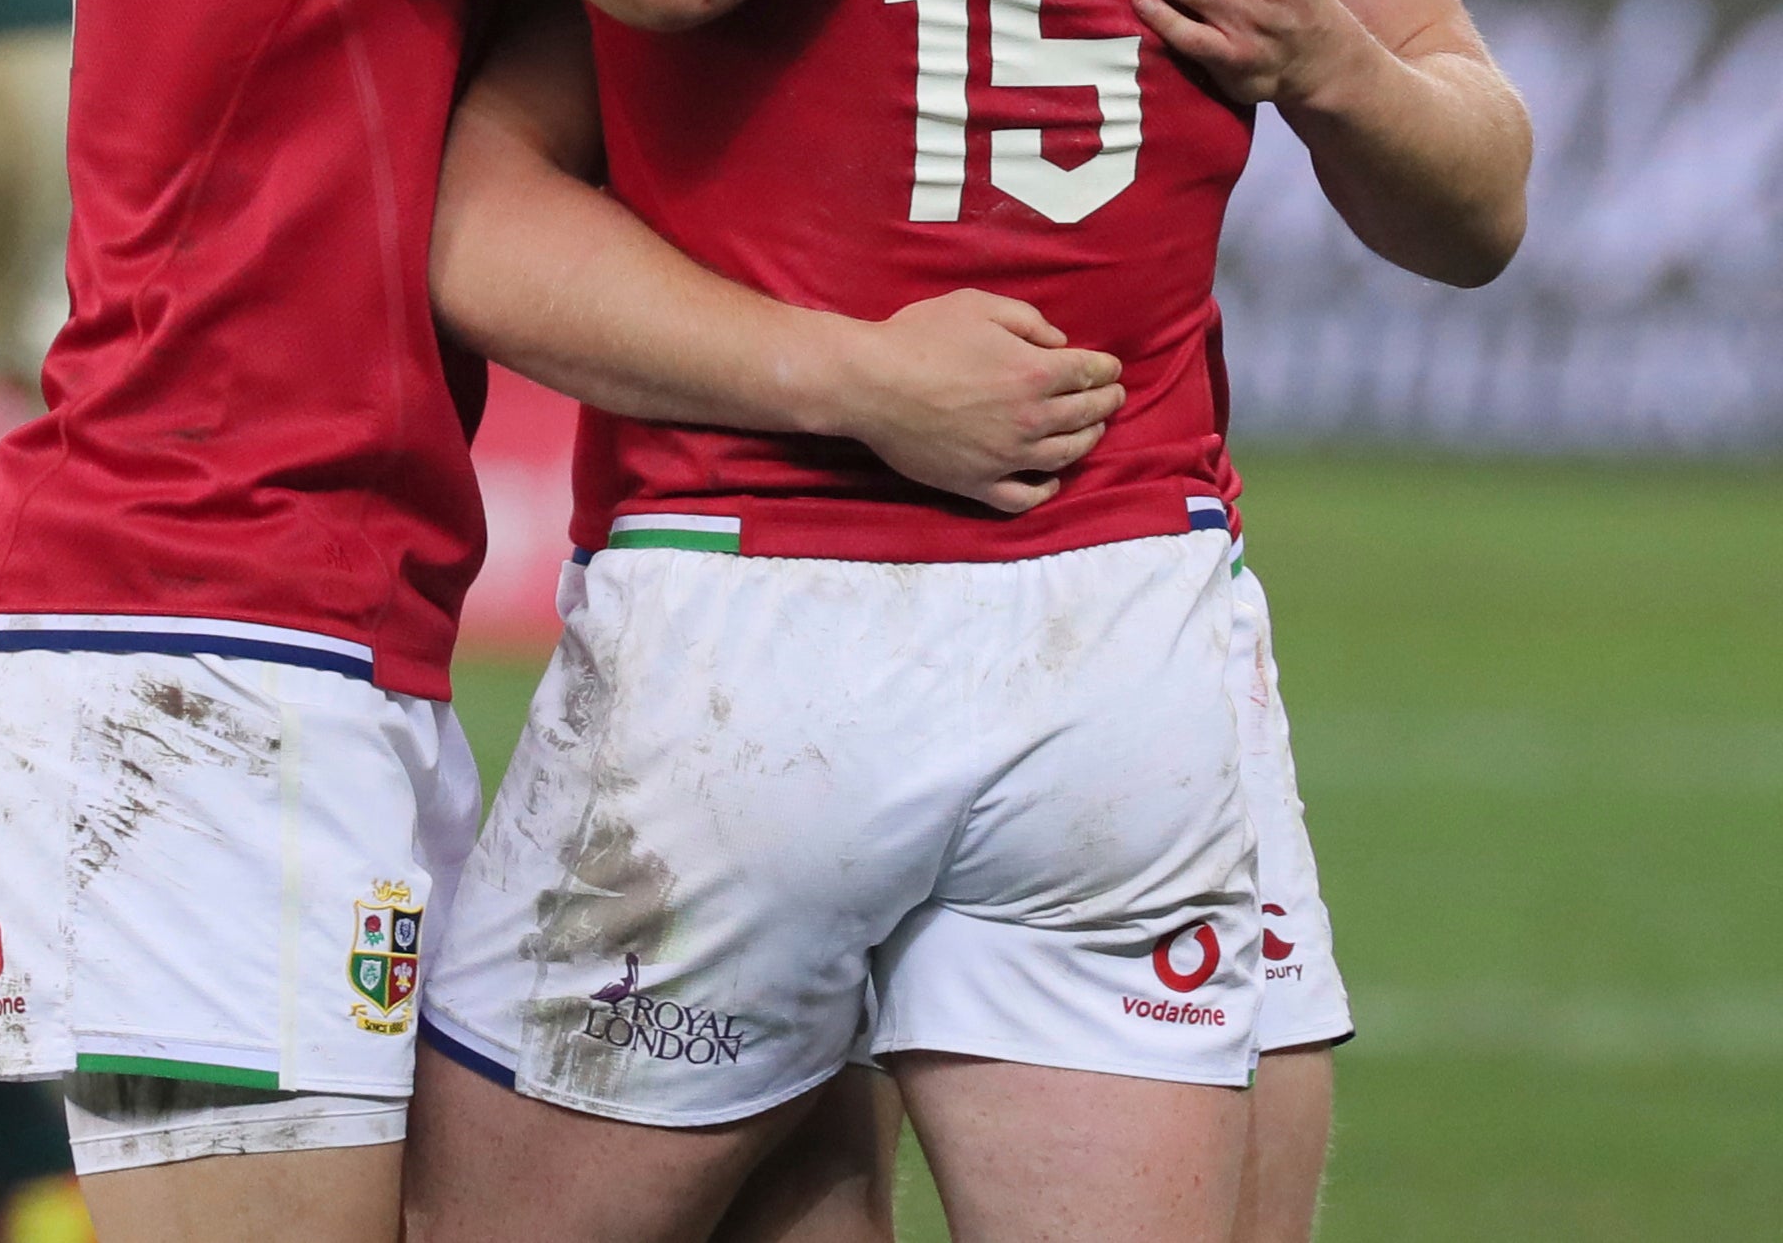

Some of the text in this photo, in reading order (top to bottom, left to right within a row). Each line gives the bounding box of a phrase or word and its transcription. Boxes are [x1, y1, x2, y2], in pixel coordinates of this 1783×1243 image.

[1265, 964, 1303, 981] bury
[630, 994, 745, 1039] ROYAL
[1123, 996, 1226, 1026] vodafone
[583, 1008, 742, 1065] LONDON
